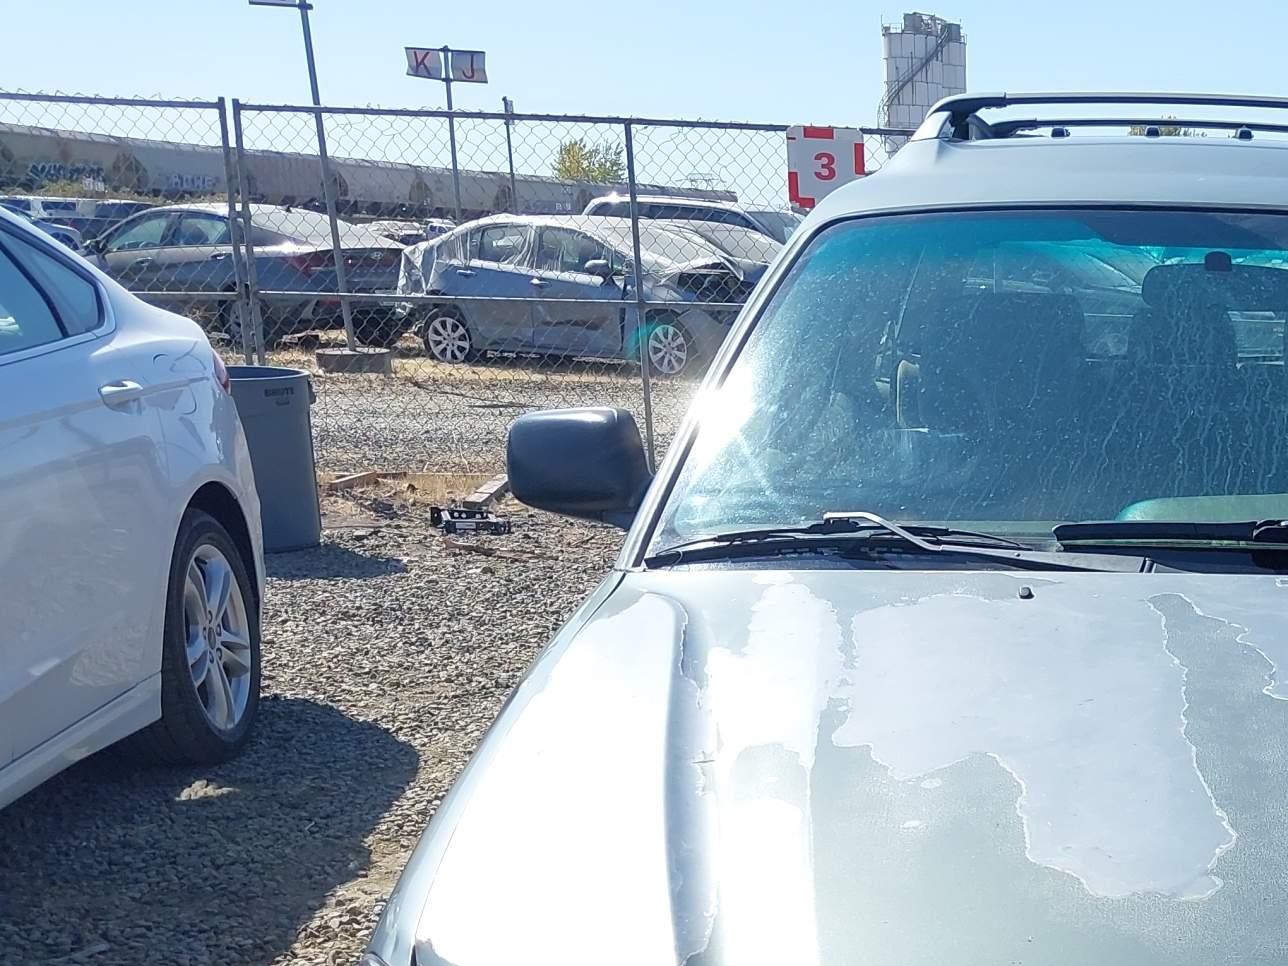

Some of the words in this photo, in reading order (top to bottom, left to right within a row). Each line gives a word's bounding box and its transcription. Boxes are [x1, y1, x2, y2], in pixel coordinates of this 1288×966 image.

[413, 51, 432, 75] K
[462, 54, 475, 79] J
[814, 152, 836, 181] 3
